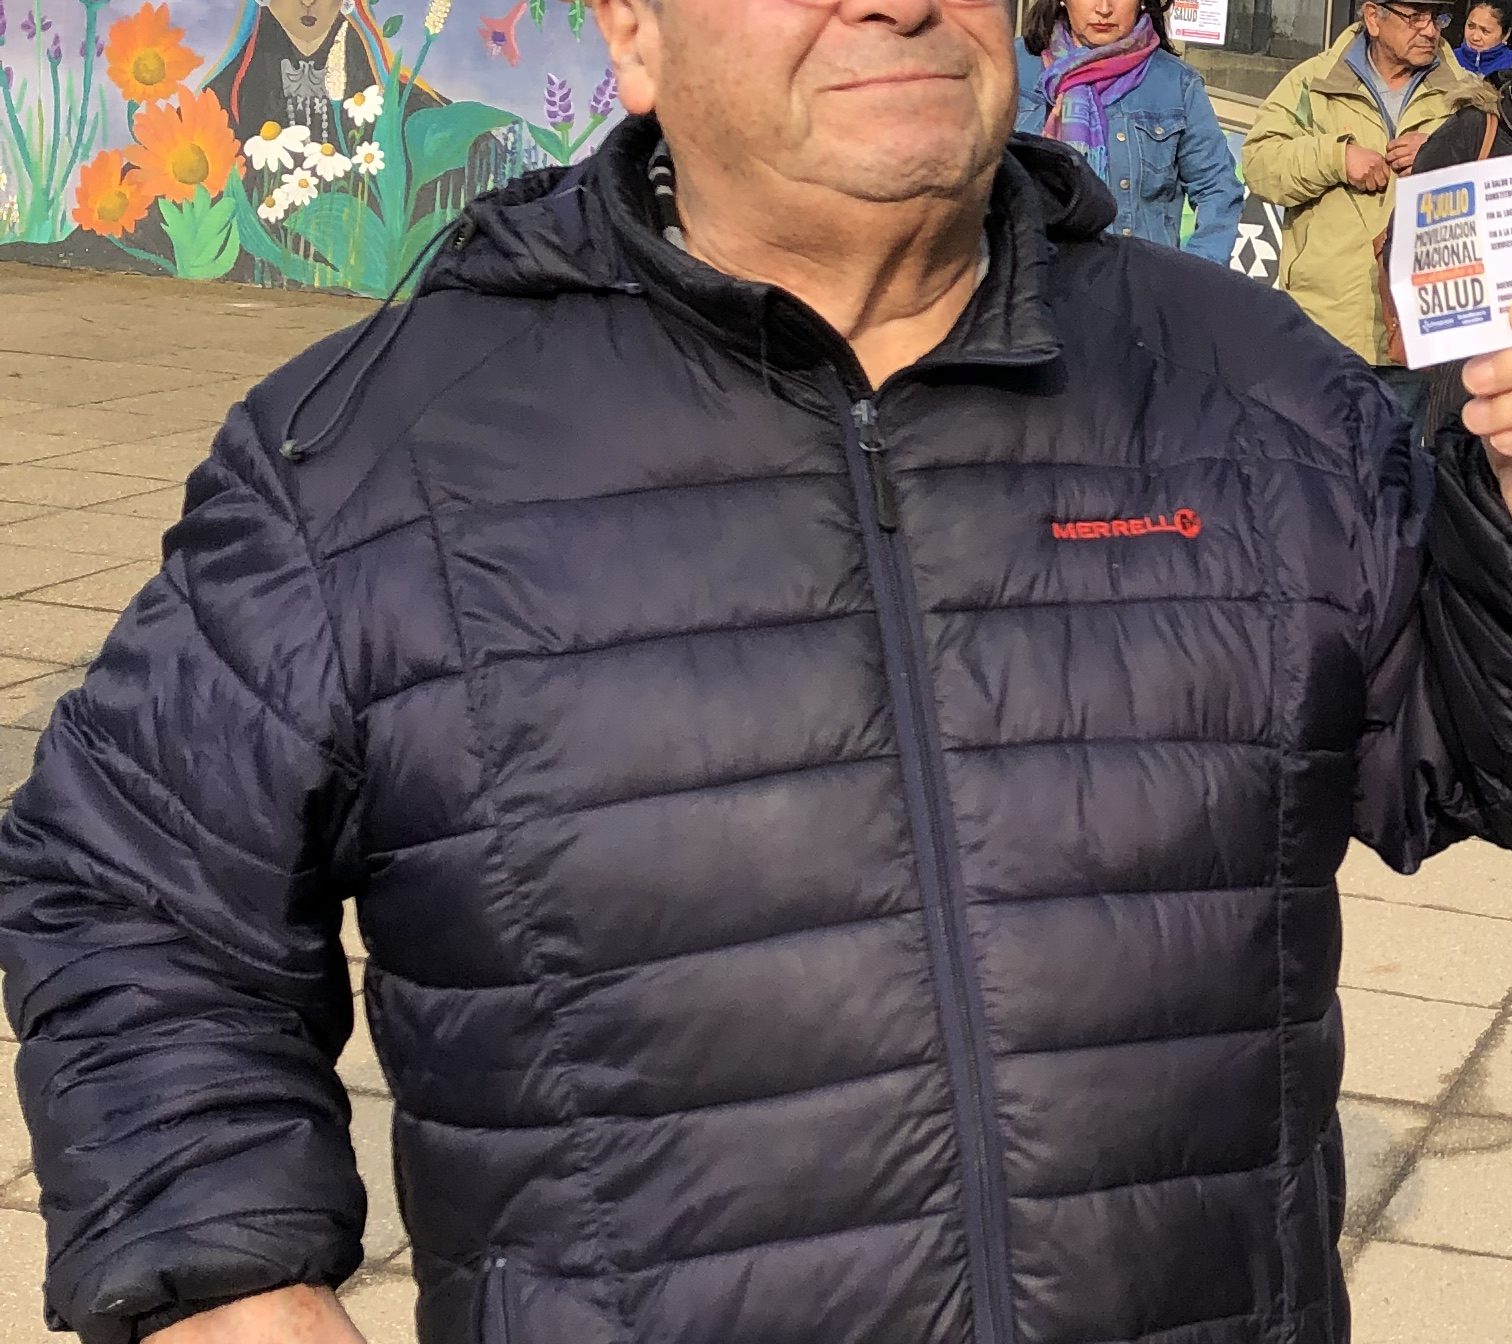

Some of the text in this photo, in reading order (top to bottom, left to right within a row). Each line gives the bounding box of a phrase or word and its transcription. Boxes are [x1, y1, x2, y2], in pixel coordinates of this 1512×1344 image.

[1415, 221, 1477, 248] MOVILIZACION
[1412, 240, 1482, 273] NACIONAL
[1418, 277, 1485, 316] SALUD
[1052, 513, 1177, 540] MERRELL
